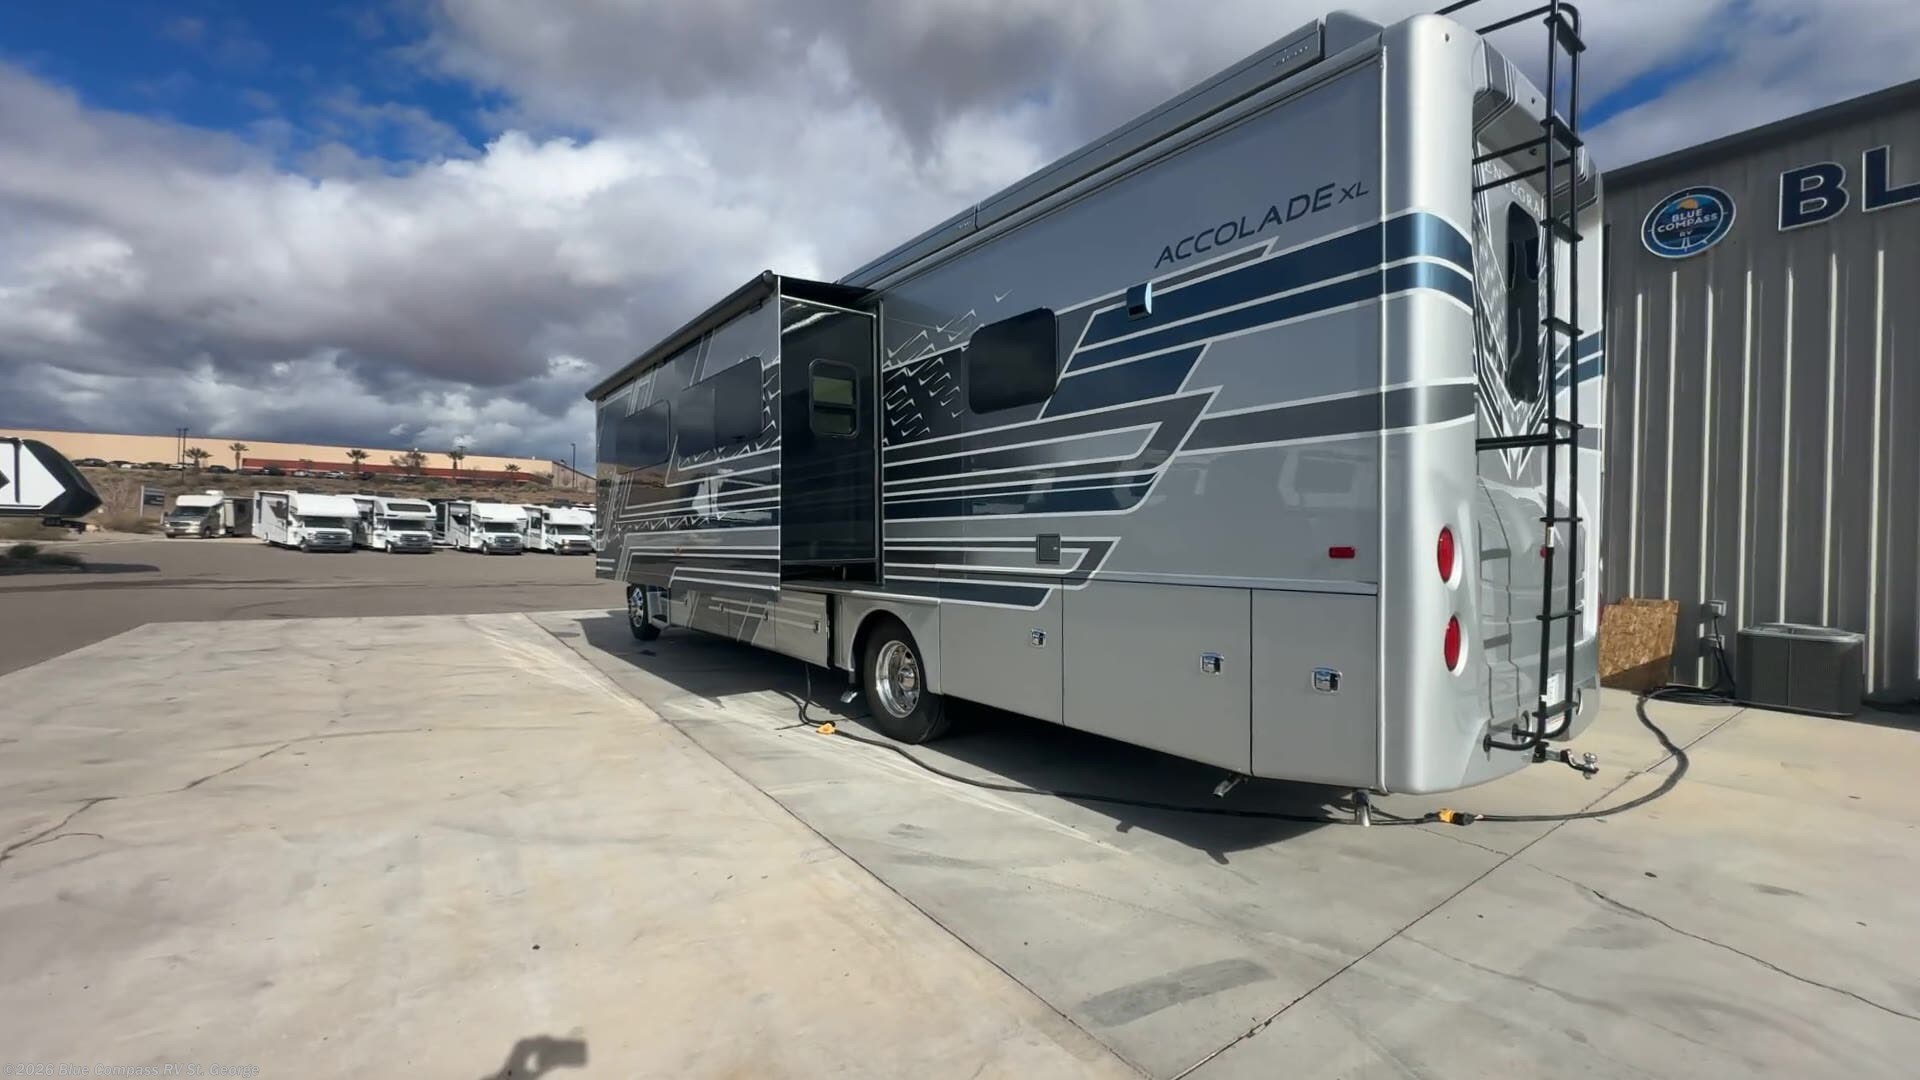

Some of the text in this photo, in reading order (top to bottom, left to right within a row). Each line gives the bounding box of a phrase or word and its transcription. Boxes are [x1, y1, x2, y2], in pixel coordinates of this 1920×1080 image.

[1657, 213, 1718, 232] COMPASS
[1671, 208, 1703, 222] BLUE
[1154, 181, 1369, 269] ACCOLADE XL
